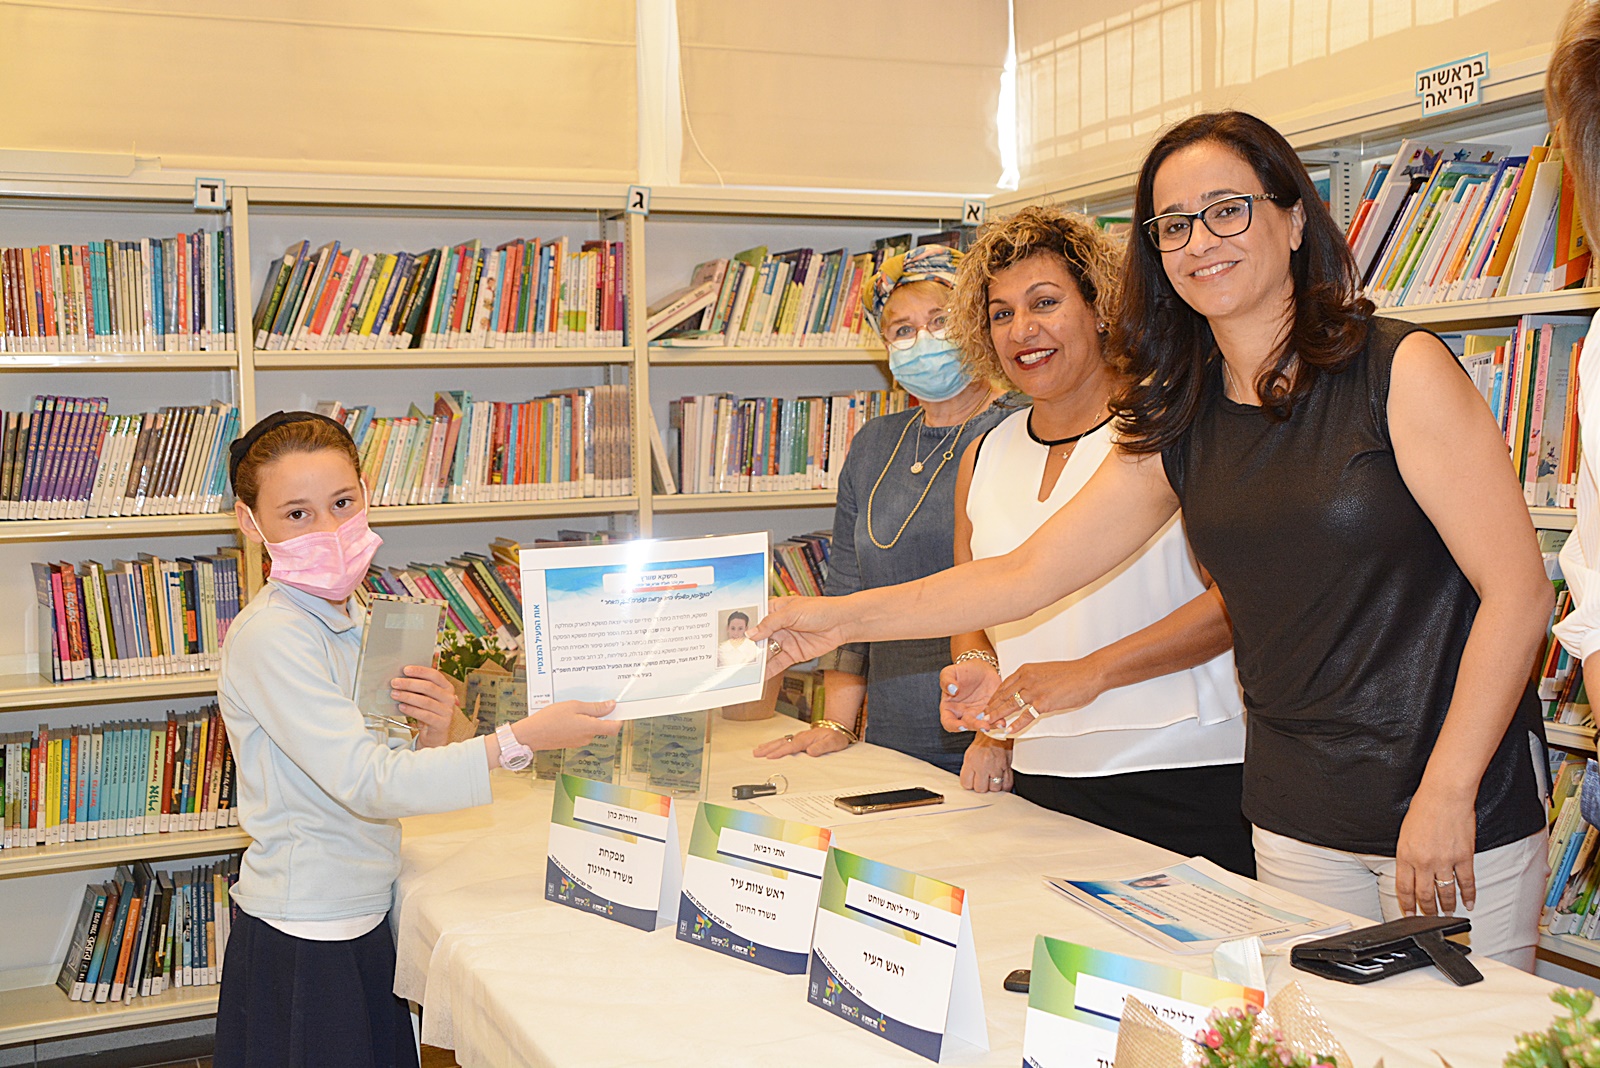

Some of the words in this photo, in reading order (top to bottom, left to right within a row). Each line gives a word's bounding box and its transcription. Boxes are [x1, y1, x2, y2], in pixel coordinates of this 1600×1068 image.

[1419, 61, 1485, 92] בראשית
[1425, 81, 1474, 108] קריאה
[200, 184, 218, 202] ד
[632, 191, 644, 208] ג
[967, 204, 980, 221] א
[533, 604, 541, 618] אות
[534, 619, 543, 644] הפעיל
[536, 644, 546, 675] המצטיין
[586, 664, 606, 672] המצטיין
[607, 810, 618, 820] כהן
[618, 813, 638, 824] דרורית
[598, 847, 625, 863] מפקחת
[753, 843, 772, 854] רביאן
[772, 847, 786, 858] אתי
[587, 862, 611, 879] החינוך
[612, 870, 634, 885] משרד
[730, 877, 744, 890] עיר
[745, 881, 764, 895] צוות
[766, 887, 785, 900] ראש
[867, 893, 886, 908] שוחט
[735, 902, 756, 915] החינוך
[886, 900, 904, 914] ליאת
[757, 909, 777, 921] משרד
[862, 950, 884, 969] העיר
[885, 959, 905, 977] ראש
[1161, 1007, 1195, 1025] דלילה
